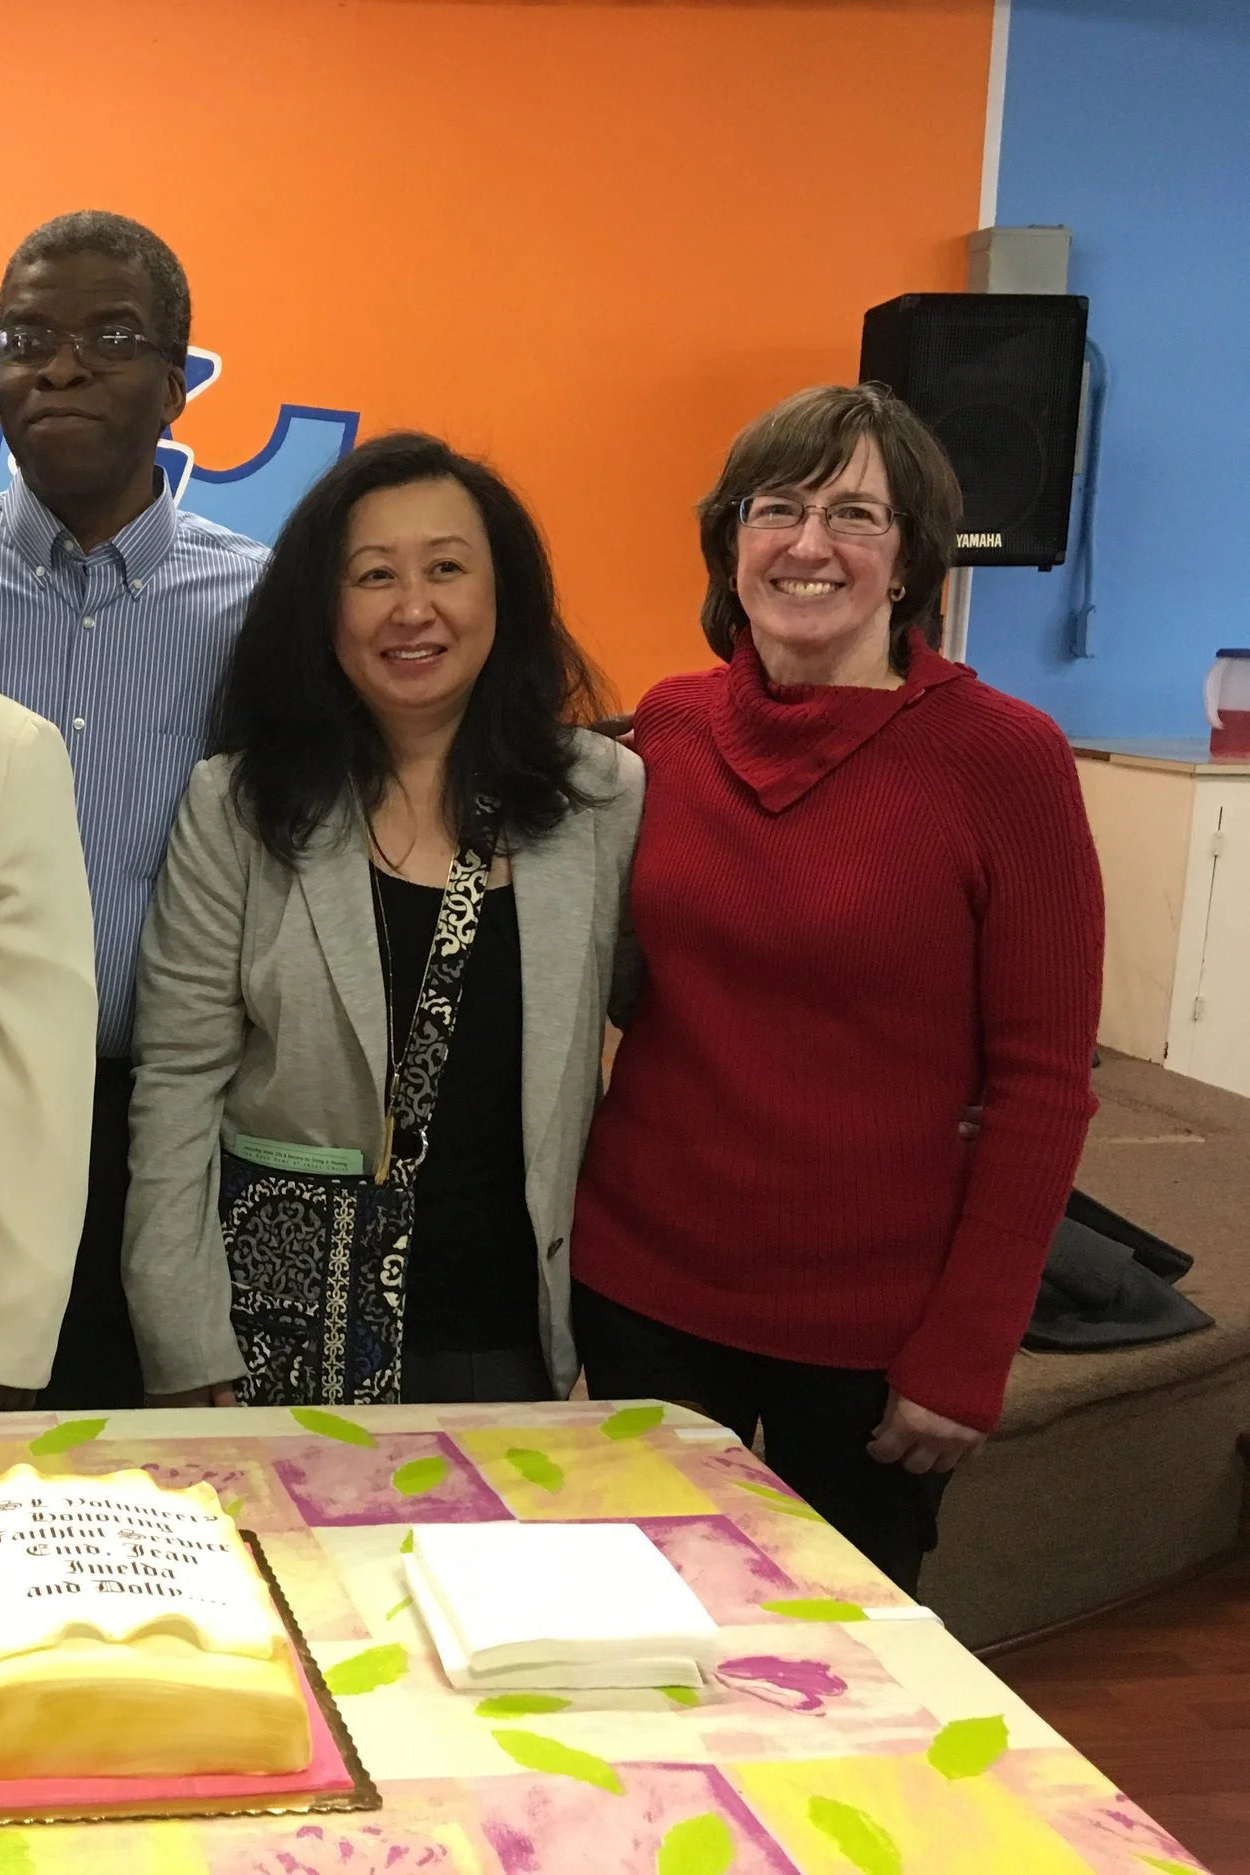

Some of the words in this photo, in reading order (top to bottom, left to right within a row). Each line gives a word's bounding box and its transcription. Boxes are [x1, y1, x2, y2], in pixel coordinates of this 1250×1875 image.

[956, 532, 1002, 548] YAMAHA
[63, 1497, 219, 1523] Volunteers
[29, 1512, 175, 1534] Honoring
[117, 1528, 231, 1553] Service
[122, 1542, 199, 1565] Jean
[63, 1559, 177, 1580] Imelda
[26, 1580, 82, 1598] and
